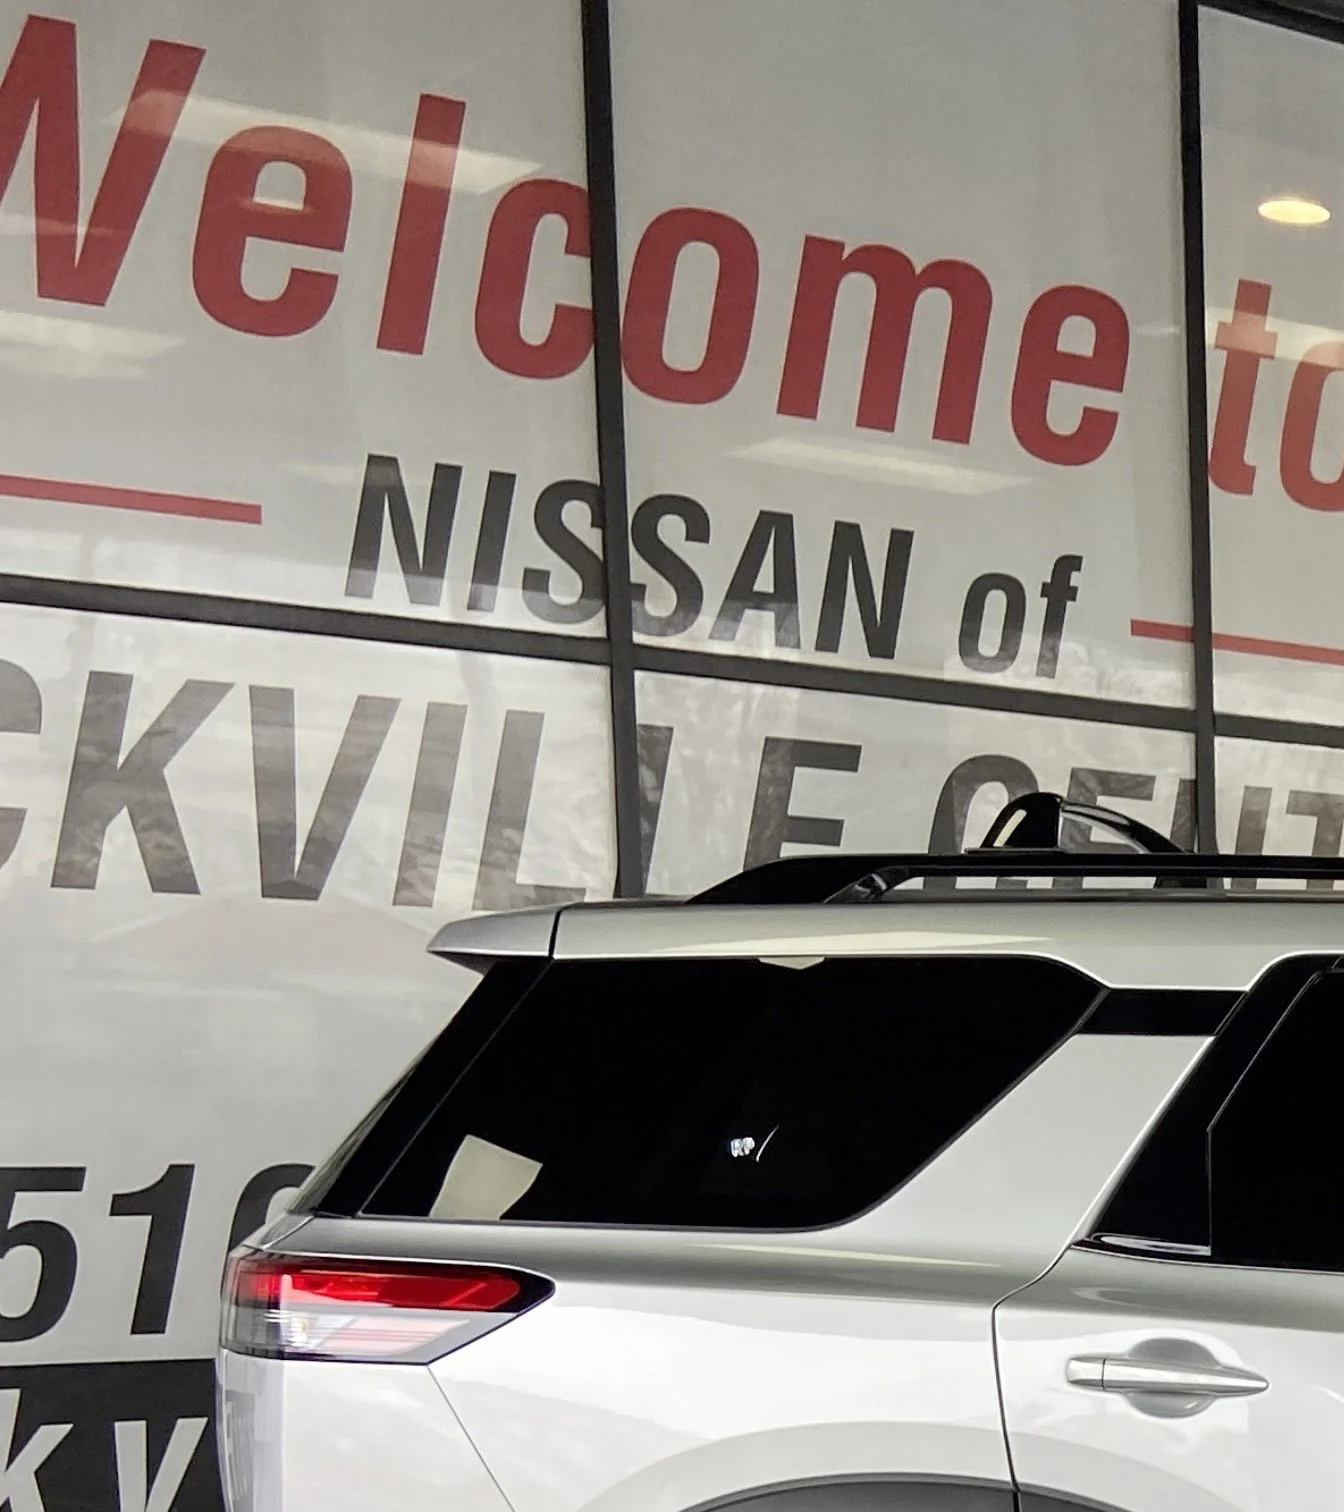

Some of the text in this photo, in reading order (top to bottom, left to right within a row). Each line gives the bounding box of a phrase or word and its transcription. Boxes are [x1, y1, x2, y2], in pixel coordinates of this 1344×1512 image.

[0, 14, 1130, 466] Welcome
[344, 453, 1084, 680] NISSAN of
